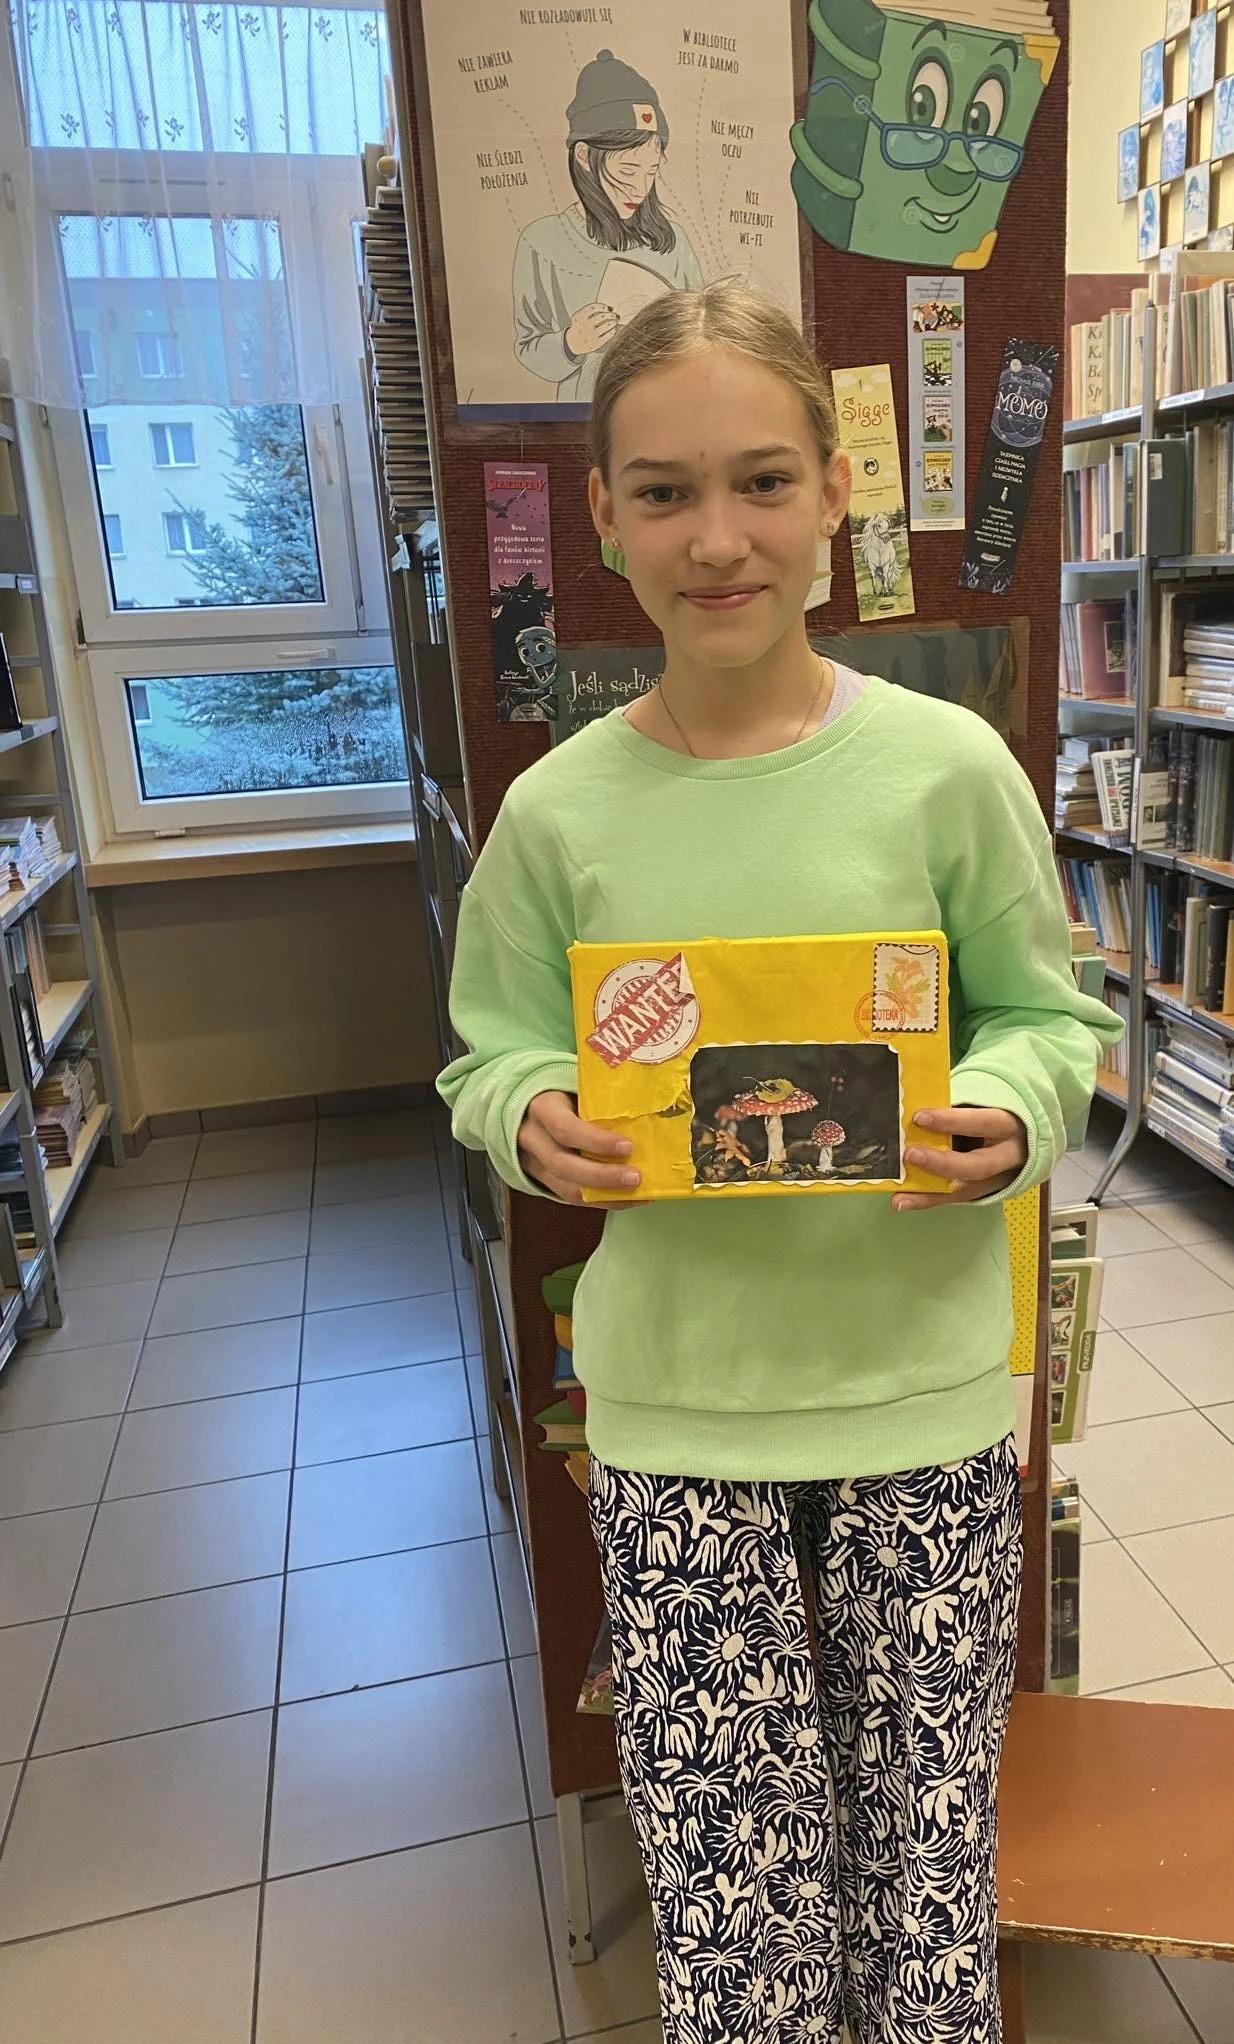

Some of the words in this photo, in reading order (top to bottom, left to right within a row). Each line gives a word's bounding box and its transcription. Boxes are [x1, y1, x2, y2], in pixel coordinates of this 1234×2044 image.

[520, 9, 536, 24] NIE
[539, 8, 597, 24] ROZŁADOWUJE
[600, 7, 613, 24] SIĘ
[683, 28, 691, 43] W
[694, 31, 736, 52] BIBLIOTECE
[457, 57, 476, 73] NIE
[478, 50, 513, 71] ZAWIERA
[677, 50, 695, 65] JEST
[698, 54, 707, 68] ZA
[710, 56, 739, 74] DARMO
[474, 74, 509, 93] REKLAM
[711, 119, 725, 135] NIE
[728, 122, 754, 140] MĘCZY
[477, 152, 493, 168] NIE
[495, 149, 523, 166] ŚLEDZI
[721, 143, 742, 158] OCZU
[480, 172, 528, 190] POŁOŻENIA
[745, 189, 760, 205] NIE
[729, 209, 774, 228] POTRZEBUJE
[740, 231, 763, 247] WI-FI
[841, 397, 890, 428] Sigge
[996, 391, 1048, 420] MOMO
[567, 670, 604, 702] Jeśli
[610, 667, 664, 696] sądzis
